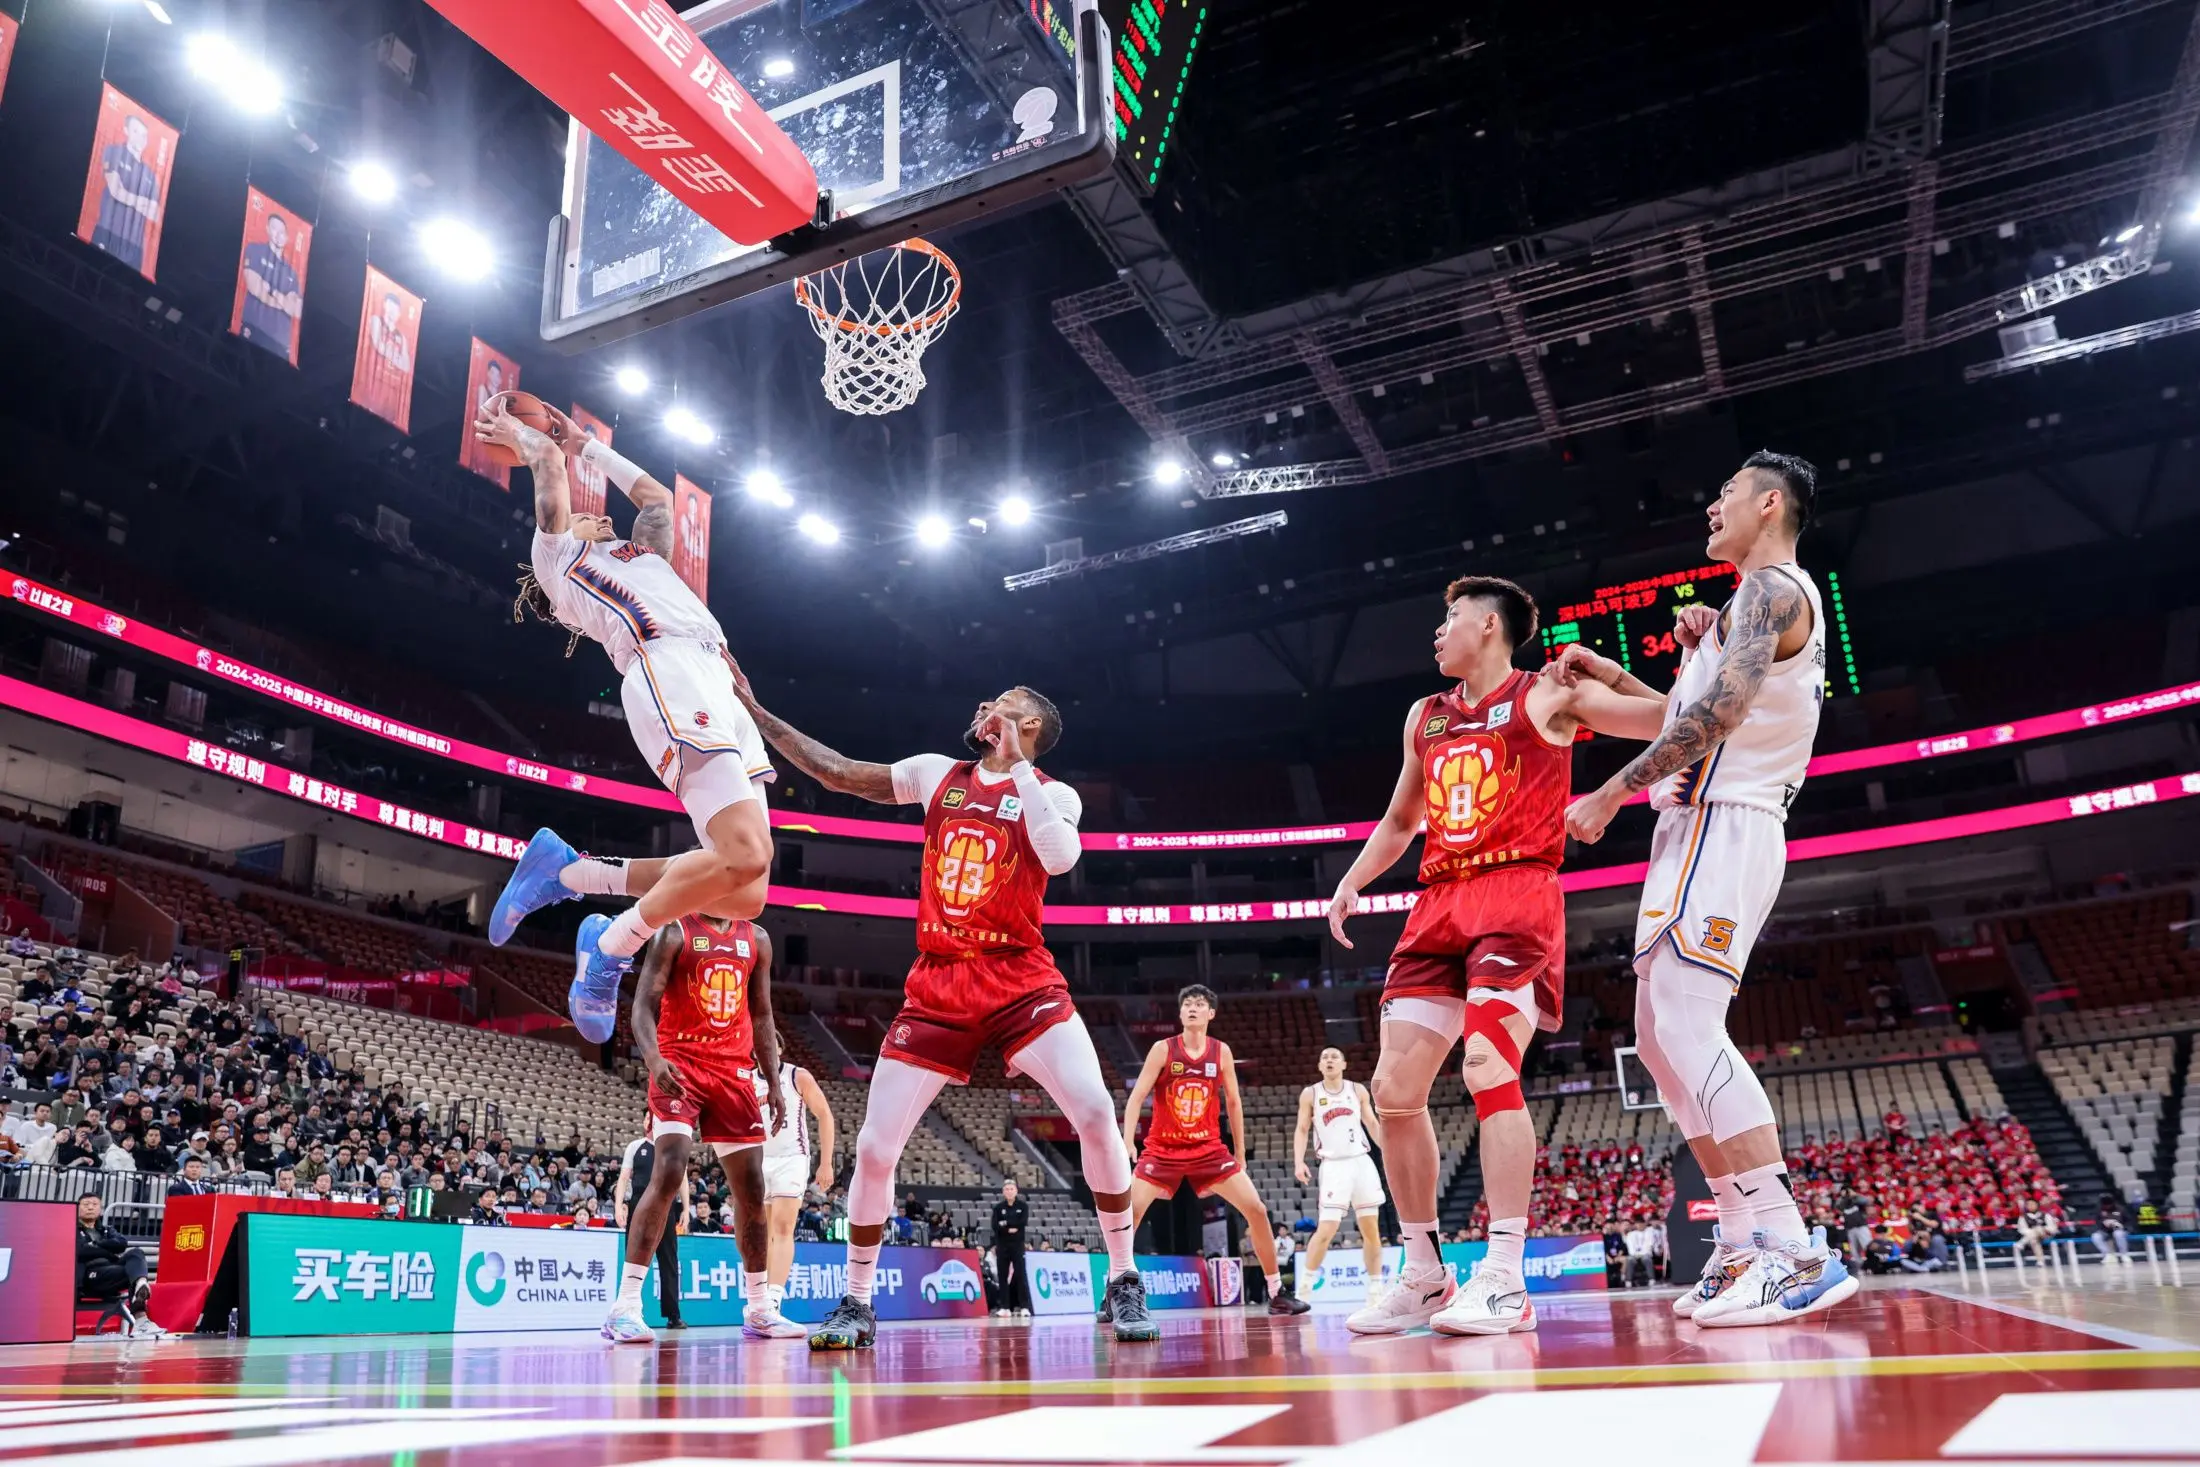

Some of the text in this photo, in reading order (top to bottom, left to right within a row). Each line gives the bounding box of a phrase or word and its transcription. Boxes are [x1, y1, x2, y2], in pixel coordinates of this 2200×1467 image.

[599, 72, 765, 208] 金陵
[1674, 583, 1695, 598] VS
[1558, 589, 1657, 622] 深圳马可波罗
[1641, 631, 1677, 657] 34
[215, 659, 282, 694] 2024-2025
[283, 684, 382, 732] 中国男子篮球职业联赛
[186, 739, 266, 785] 遵守规则
[287, 772, 358, 813] 尊重对手
[378, 802, 445, 841] 尊重裁判
[1450, 782, 1473, 822] 8
[1132, 835, 1188, 846] 2024-2025
[941, 856, 986, 896] 23
[1180, 1099, 1203, 1118] 33
[292, 1248, 437, 1301] 买车险
[514, 1256, 606, 1283] 中国人寿
[1052, 1270, 1086, 1285] 中国人寿
[517, 1288, 607, 1302] CHINA LIFE
[1055, 1288, 1089, 1297] CHINA LIFE
